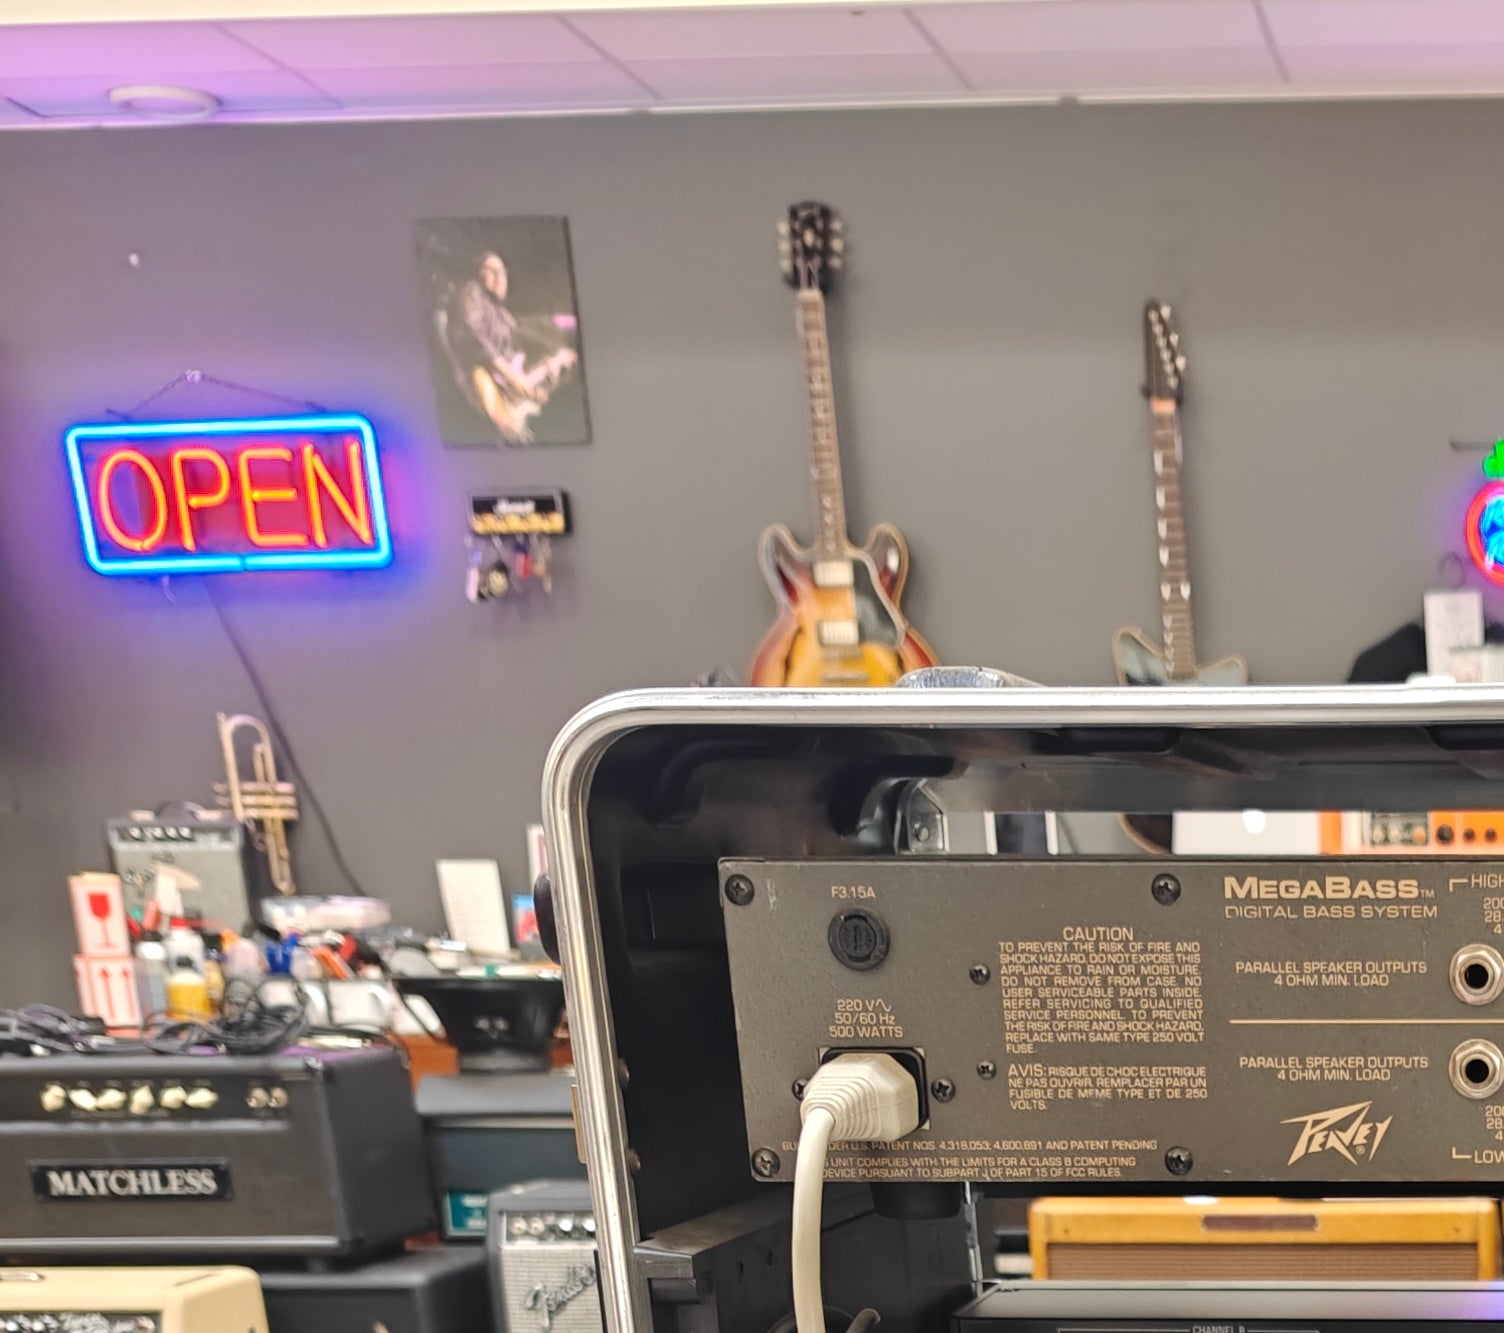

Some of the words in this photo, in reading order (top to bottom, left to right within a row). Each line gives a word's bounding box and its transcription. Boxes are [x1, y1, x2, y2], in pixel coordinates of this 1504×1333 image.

[96, 439, 374, 554] OPEN
[831, 886, 876, 898] F3.15A
[1226, 906, 1298, 919] DIGITAL
[1304, 906, 1356, 919] BASS
[1361, 906, 1437, 919] SYSTEM
[1063, 927, 1134, 941] CAUTION
[1493, 924, 1502, 935] 4
[999, 942, 1014, 952] TO
[1018, 942, 1068, 952] PREVENT
[1073, 942, 1094, 952] THE
[1100, 942, 1124, 952] RISK
[1129, 942, 1143, 952] OF
[1148, 942, 1170, 952] FIRE
[1176, 942, 1200, 952] AND
[1000, 965, 1061, 975] APPLIANCE
[1067, 965, 1081, 975] TO
[1087, 965, 1114, 975] RAIN
[1119, 965, 1135, 975] OR
[1236, 962, 1300, 973] PARALLEL
[1304, 962, 1362, 973] SPEAKER
[1366, 962, 1426, 973] OUTPUTS
[1002, 976, 1018, 986] DO
[1025, 976, 1048, 986] NOT
[1054, 976, 1101, 986] REMOVE
[1108, 976, 1140, 986] FROM
[1185, 976, 1201, 986] NO
[1274, 974, 1282, 986] 4
[1286, 974, 1318, 986] OHM
[1322, 974, 1350, 986] MIN.
[1354, 974, 1389, 986] LOAD
[837, 1000, 862, 1011] 220
[866, 1000, 875, 1011] V
[835, 1013, 876, 1025] 50/60
[880, 1013, 895, 1025] Hz
[829, 1027, 854, 1038] 500
[857, 1027, 903, 1038] WATTS
[1240, 1057, 1302, 1068] PARALLEL
[1306, 1057, 1364, 1068] SPEAKER
[1369, 1057, 1428, 1068] OUTPUTS
[1277, 1070, 1286, 1080] 4
[1289, 1070, 1320, 1080] OHM
[1324, 1070, 1352, 1080] MIN.
[1356, 1070, 1390, 1080] LOAD
[1495, 1131, 1503, 1141] 4
[46, 1168, 218, 1196] MATCHLESS
